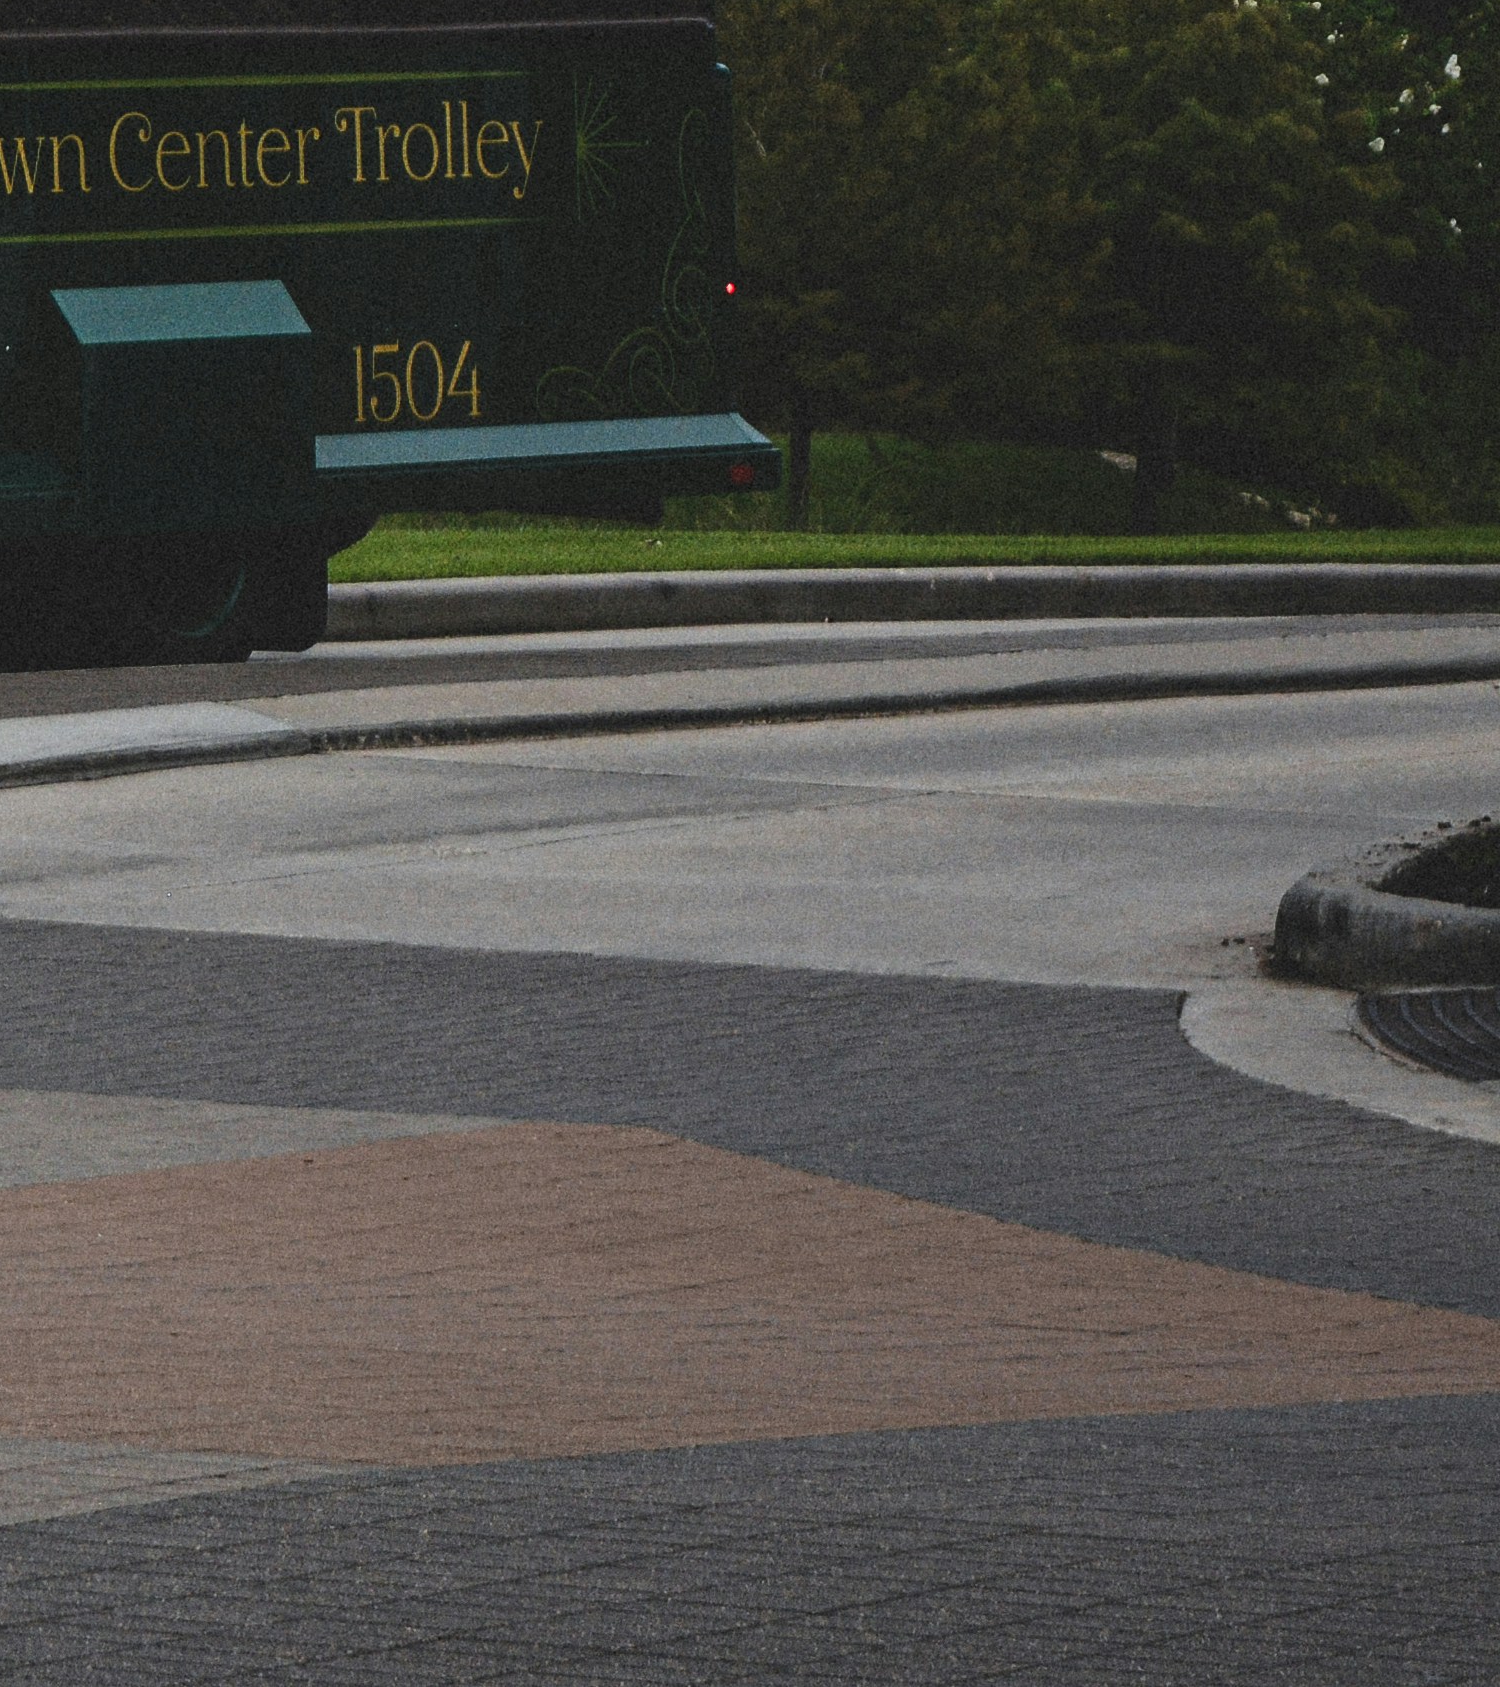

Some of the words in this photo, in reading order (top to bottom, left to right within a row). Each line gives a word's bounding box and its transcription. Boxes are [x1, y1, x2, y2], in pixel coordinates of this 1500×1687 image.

[108, 110, 321, 193] Center
[334, 100, 543, 200] Trolley
[353, 340, 482, 424] 1504
